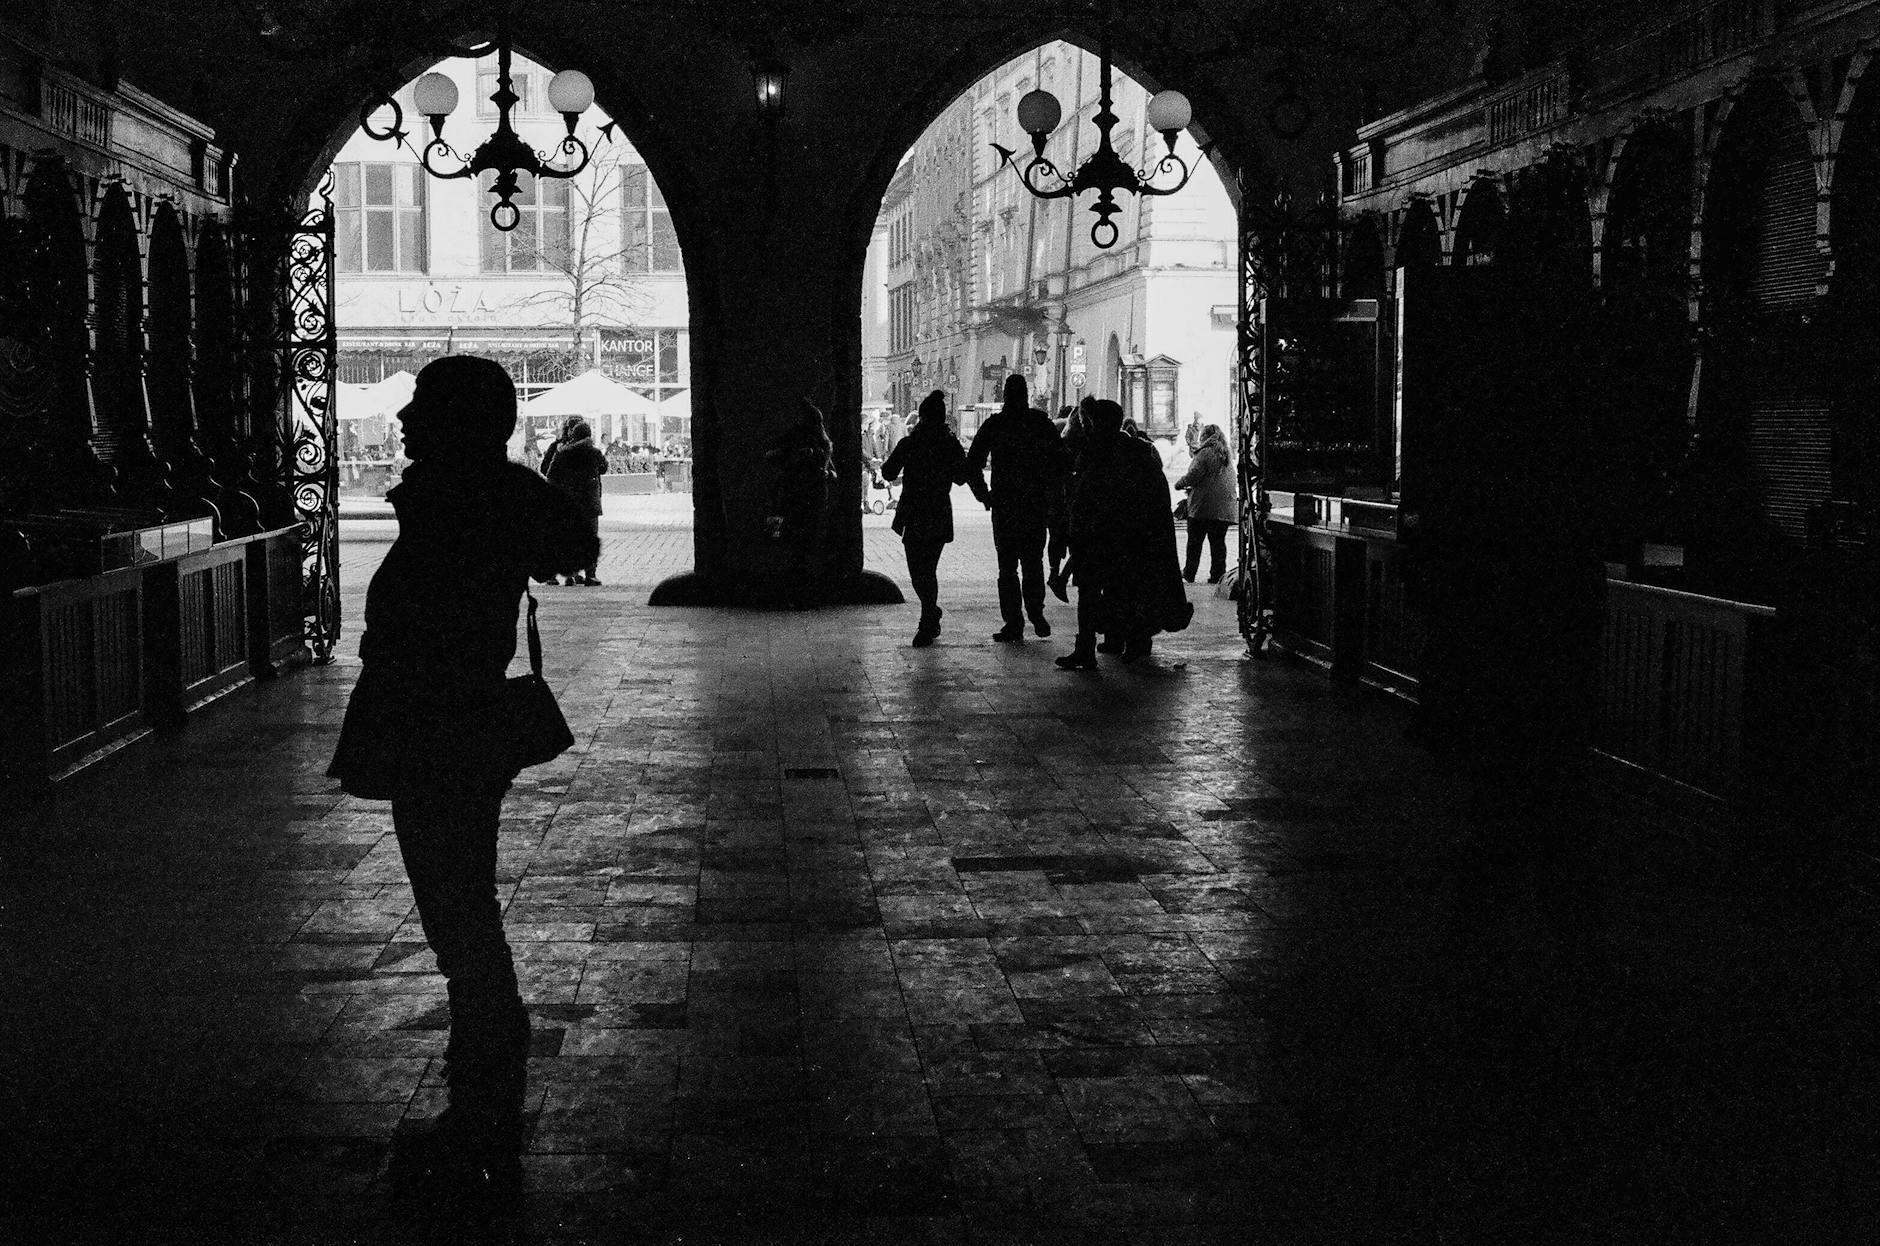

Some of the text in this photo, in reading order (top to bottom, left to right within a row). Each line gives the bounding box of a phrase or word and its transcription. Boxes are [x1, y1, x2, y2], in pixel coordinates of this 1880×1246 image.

[601, 340, 654, 352] KANTOR
[1073, 347, 1083, 359] P
[1024, 366, 1032, 377] P
